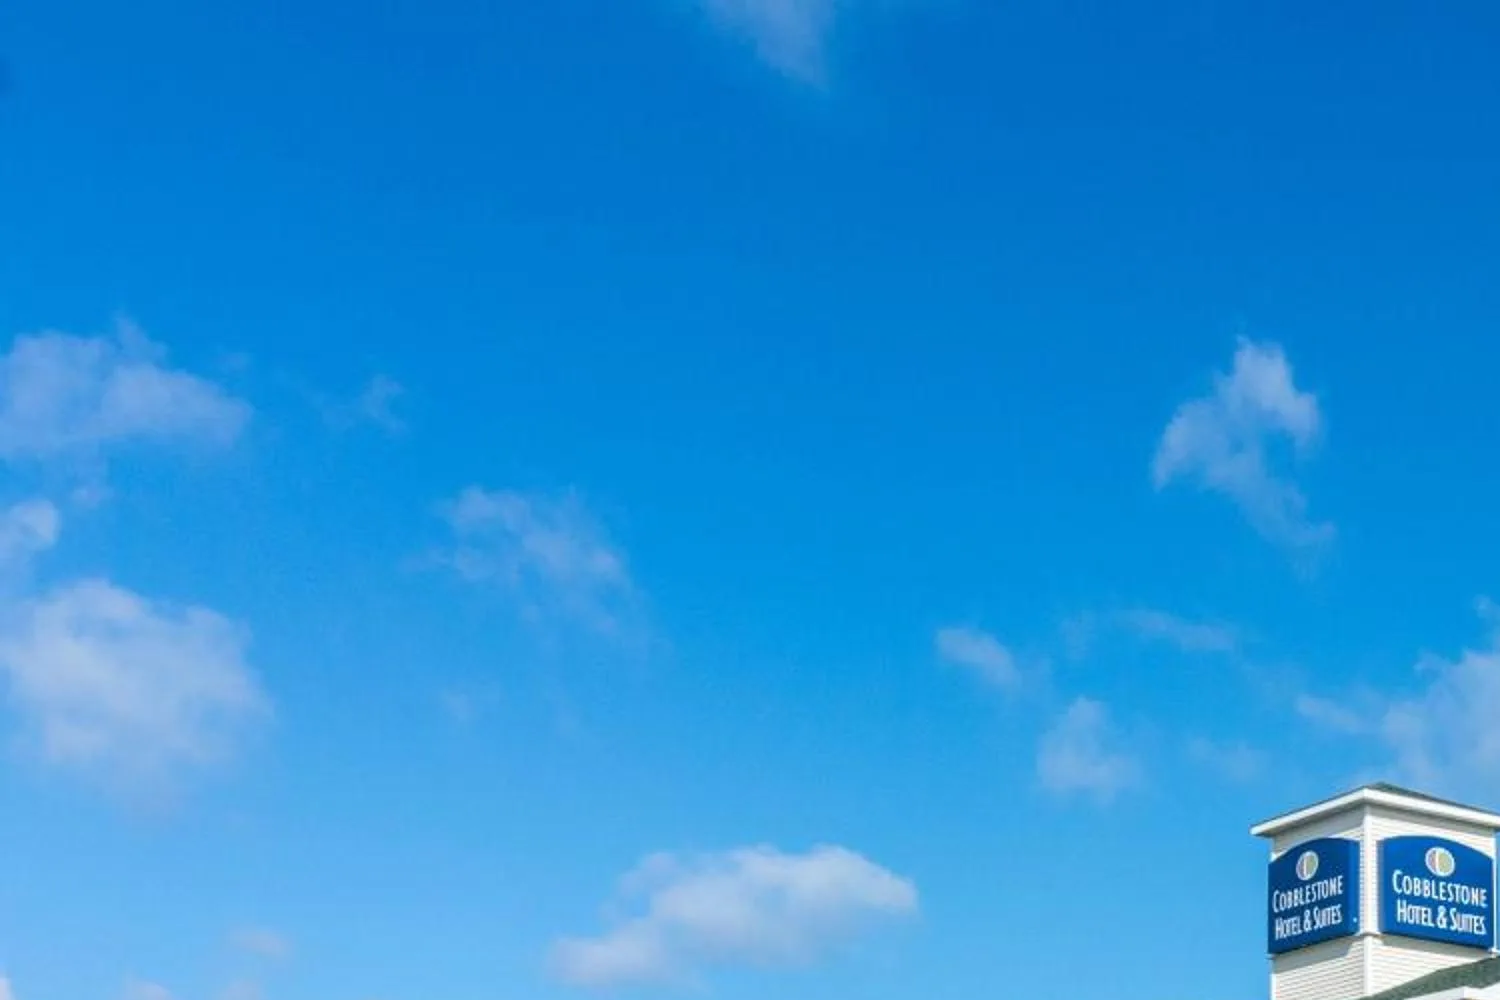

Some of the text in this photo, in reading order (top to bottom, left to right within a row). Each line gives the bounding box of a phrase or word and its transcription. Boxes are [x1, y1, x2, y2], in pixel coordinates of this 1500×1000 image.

[1273, 875, 1344, 913] COBBLESTONE
[1392, 869, 1488, 908] COBBLESTONE
[1275, 904, 1343, 940] HOTEL & SUITES
[1397, 898, 1487, 935] HOTEL & SUITES
